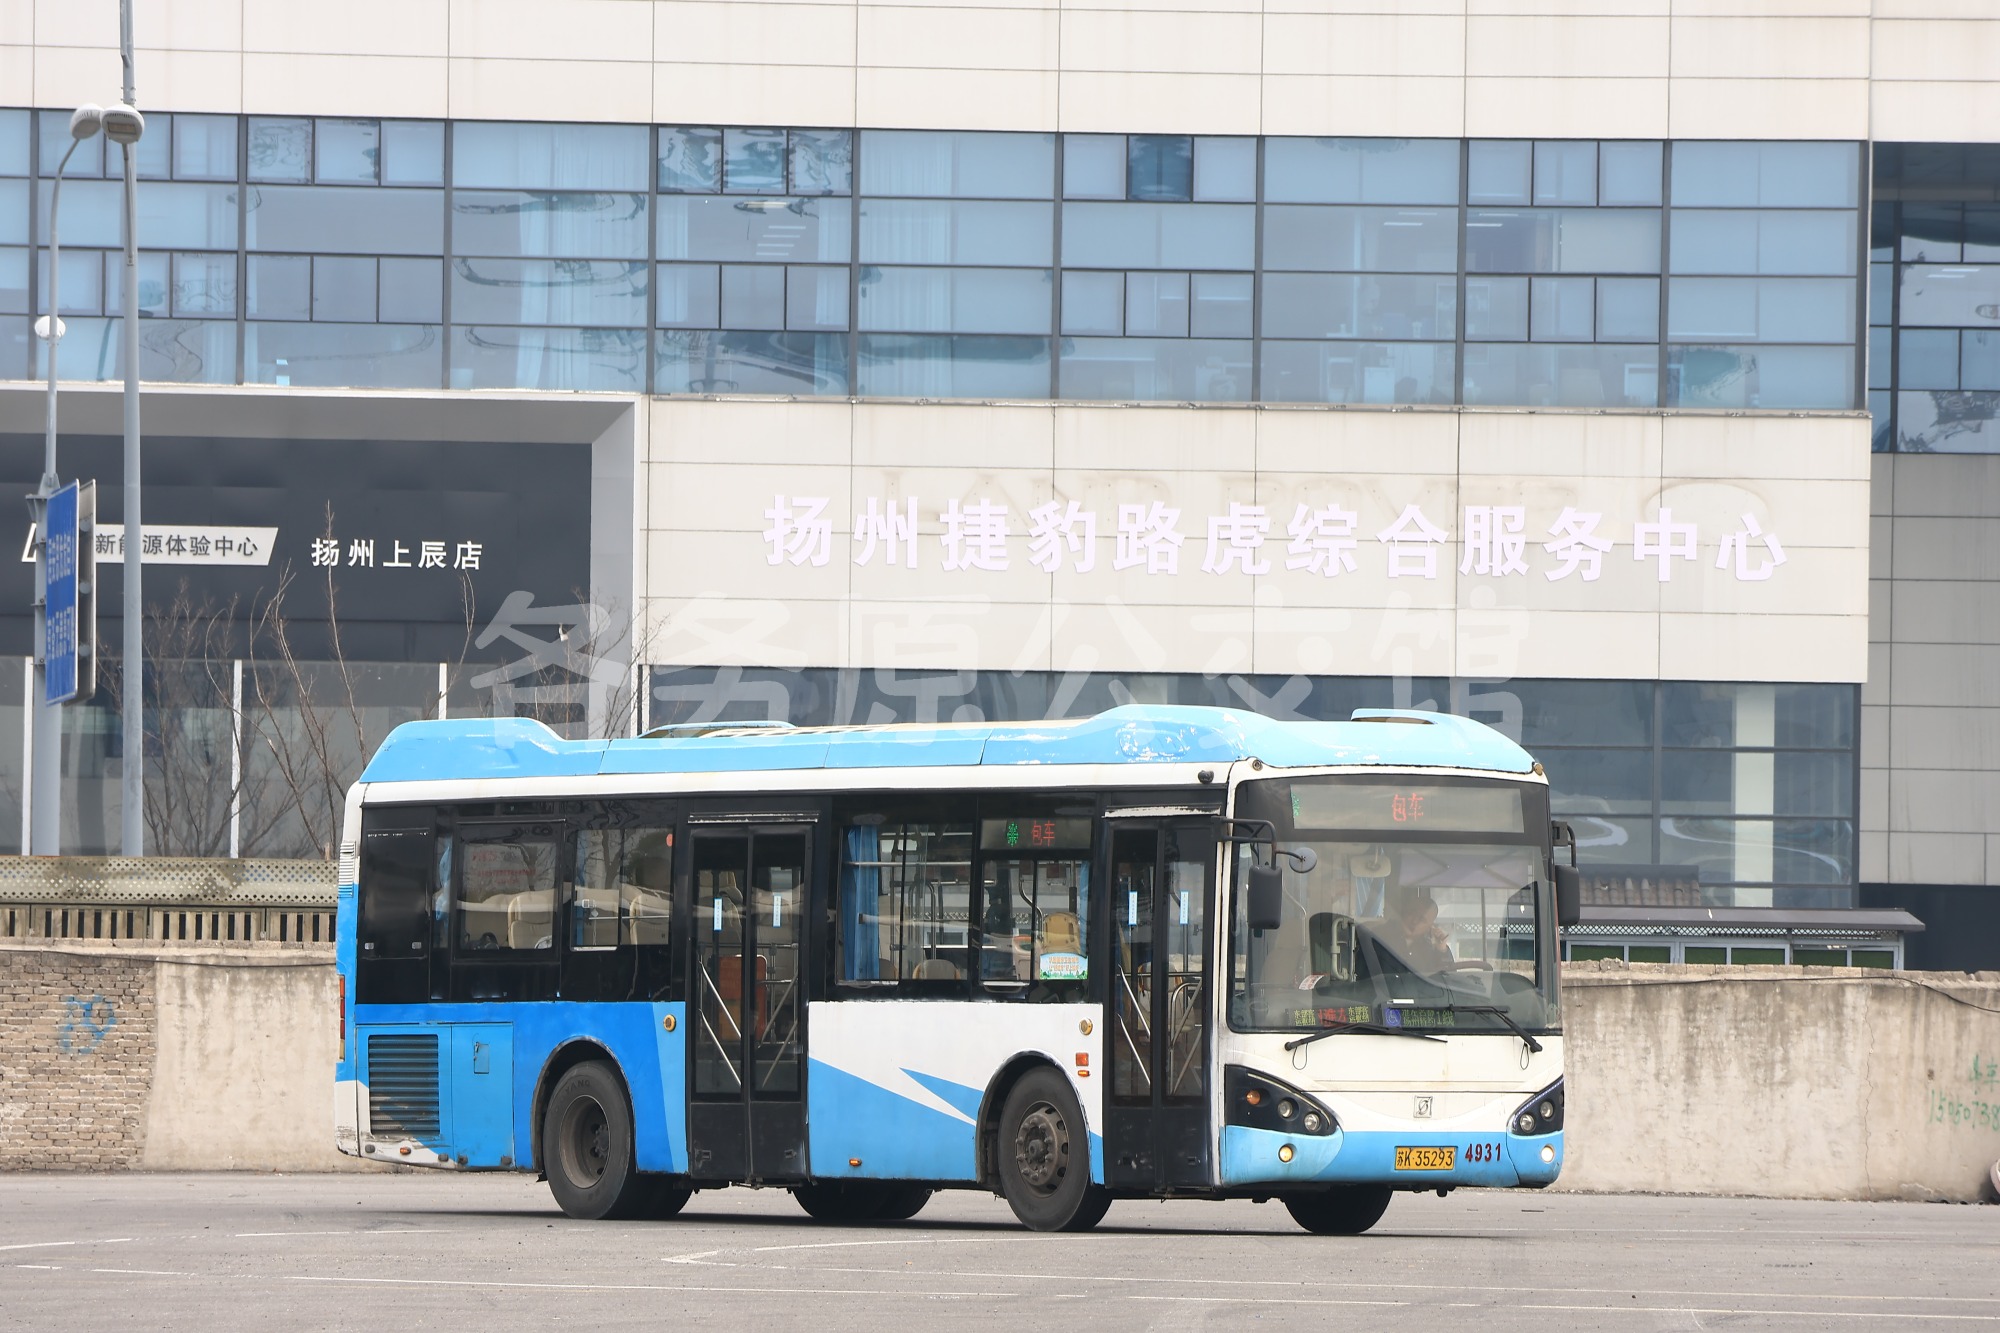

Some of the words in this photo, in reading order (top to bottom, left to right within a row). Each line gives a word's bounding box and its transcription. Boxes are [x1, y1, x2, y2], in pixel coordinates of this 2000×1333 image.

[95, 533, 258, 557] 新源体验中心
[762, 494, 1787, 584] 扬州捷豹路虎综合服务中心
[311, 537, 483, 570] 扬州上辰店
[1392, 793, 1424, 822] 包车
[1031, 819, 1056, 847] 包车
[1465, 1143, 1501, 1163] 4931
